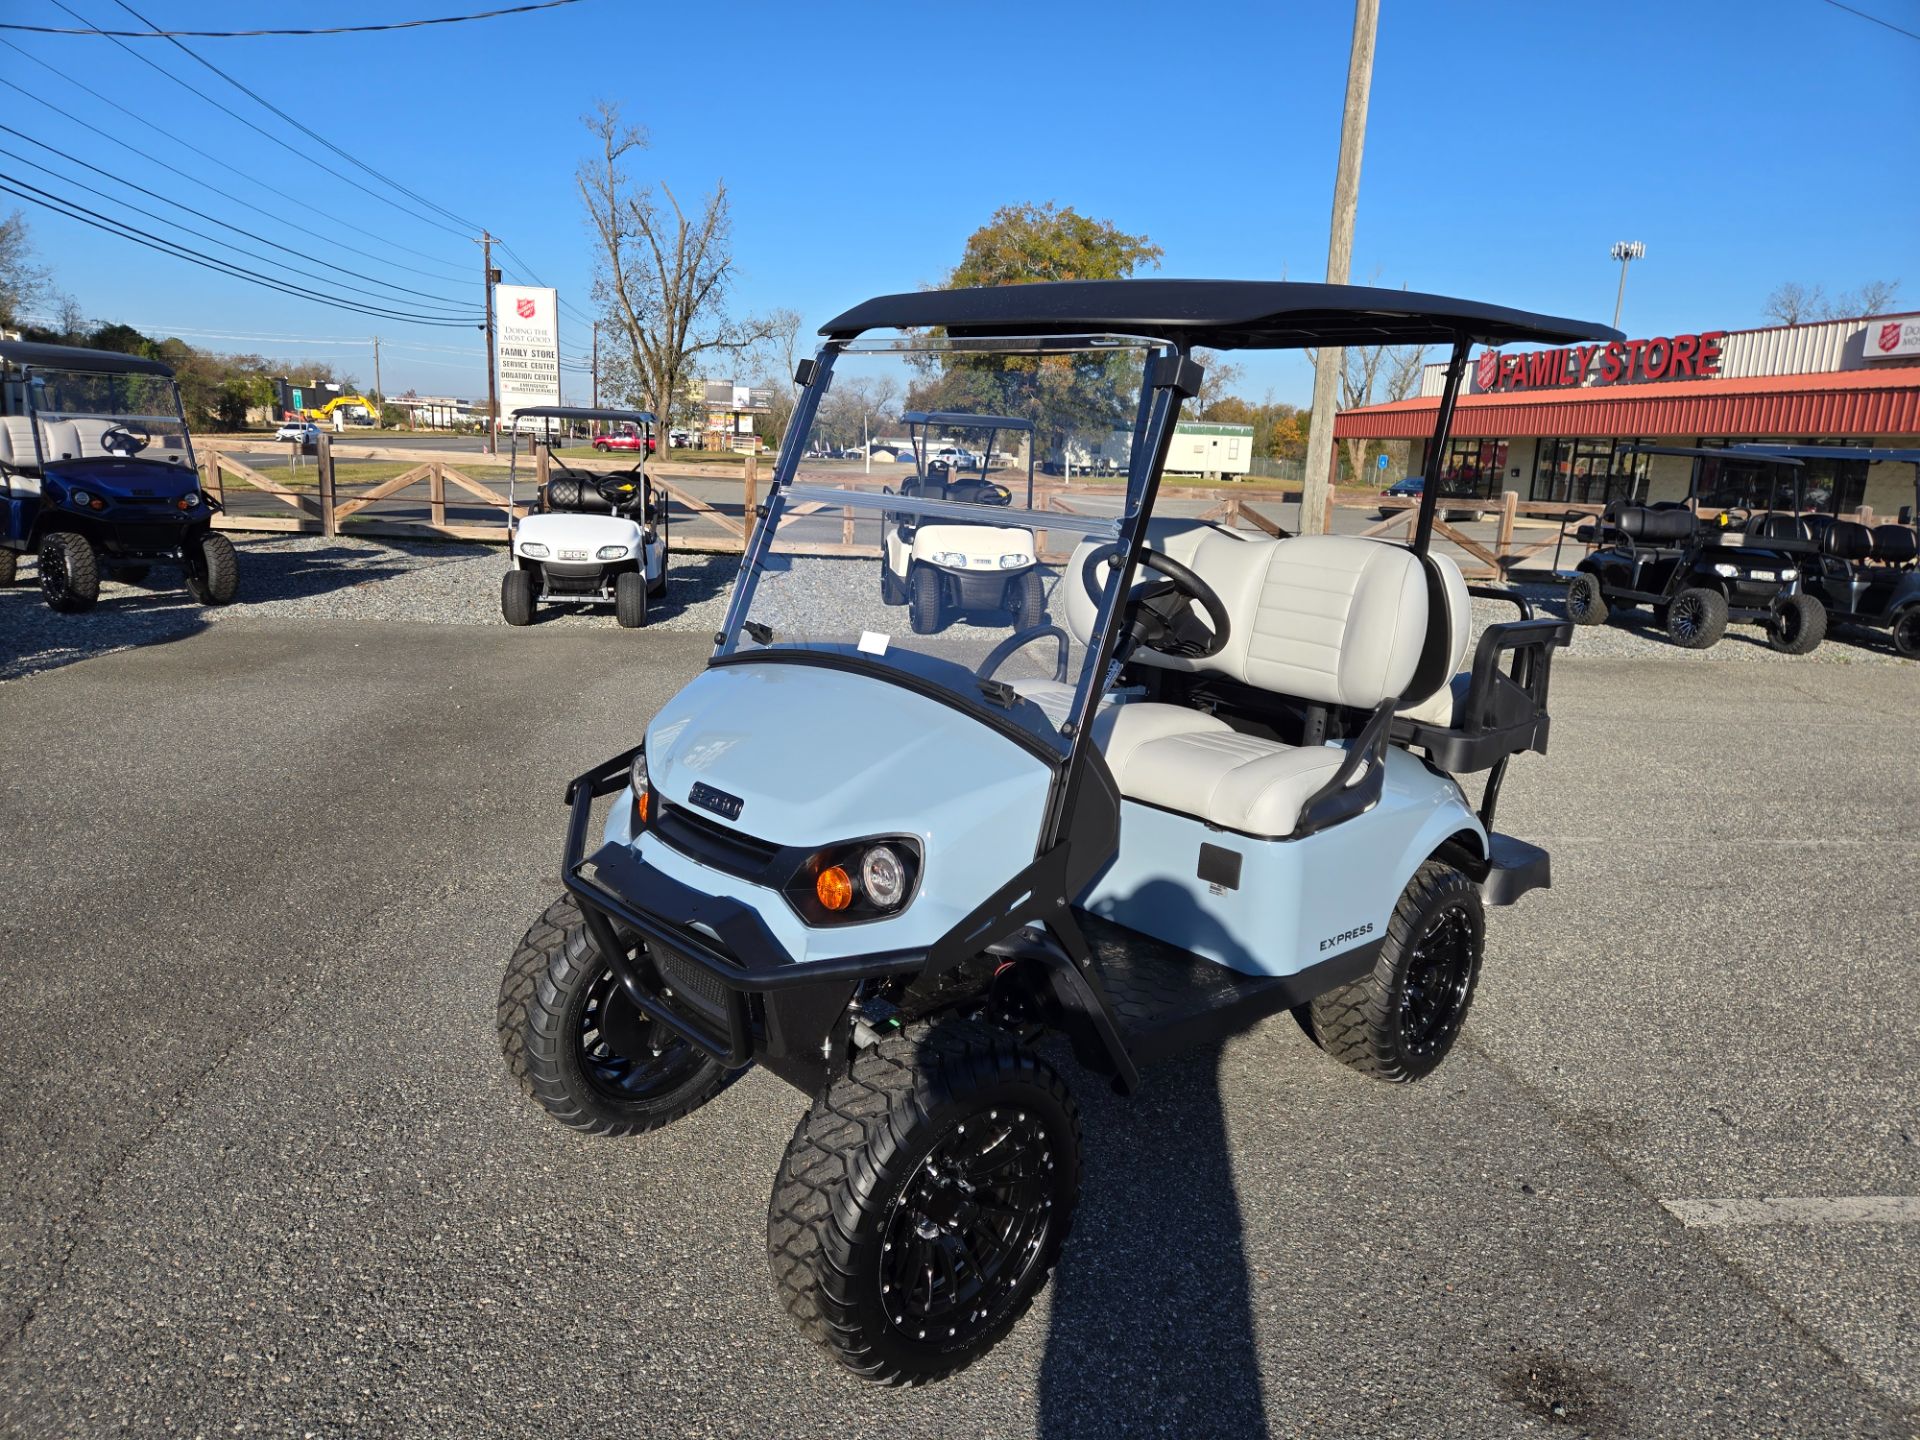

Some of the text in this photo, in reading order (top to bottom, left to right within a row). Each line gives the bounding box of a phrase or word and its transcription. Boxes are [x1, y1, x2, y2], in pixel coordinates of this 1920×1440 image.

[505, 326, 548, 336] DOING THE
[500, 347, 555, 359] FAMILY STORE
[1498, 332, 1725, 387] FAMILY STORE
[502, 360, 555, 371] SERVICE CENTER
[501, 371, 557, 382] DONATION CENTER
[1319, 922, 1374, 952] EXPRESS
